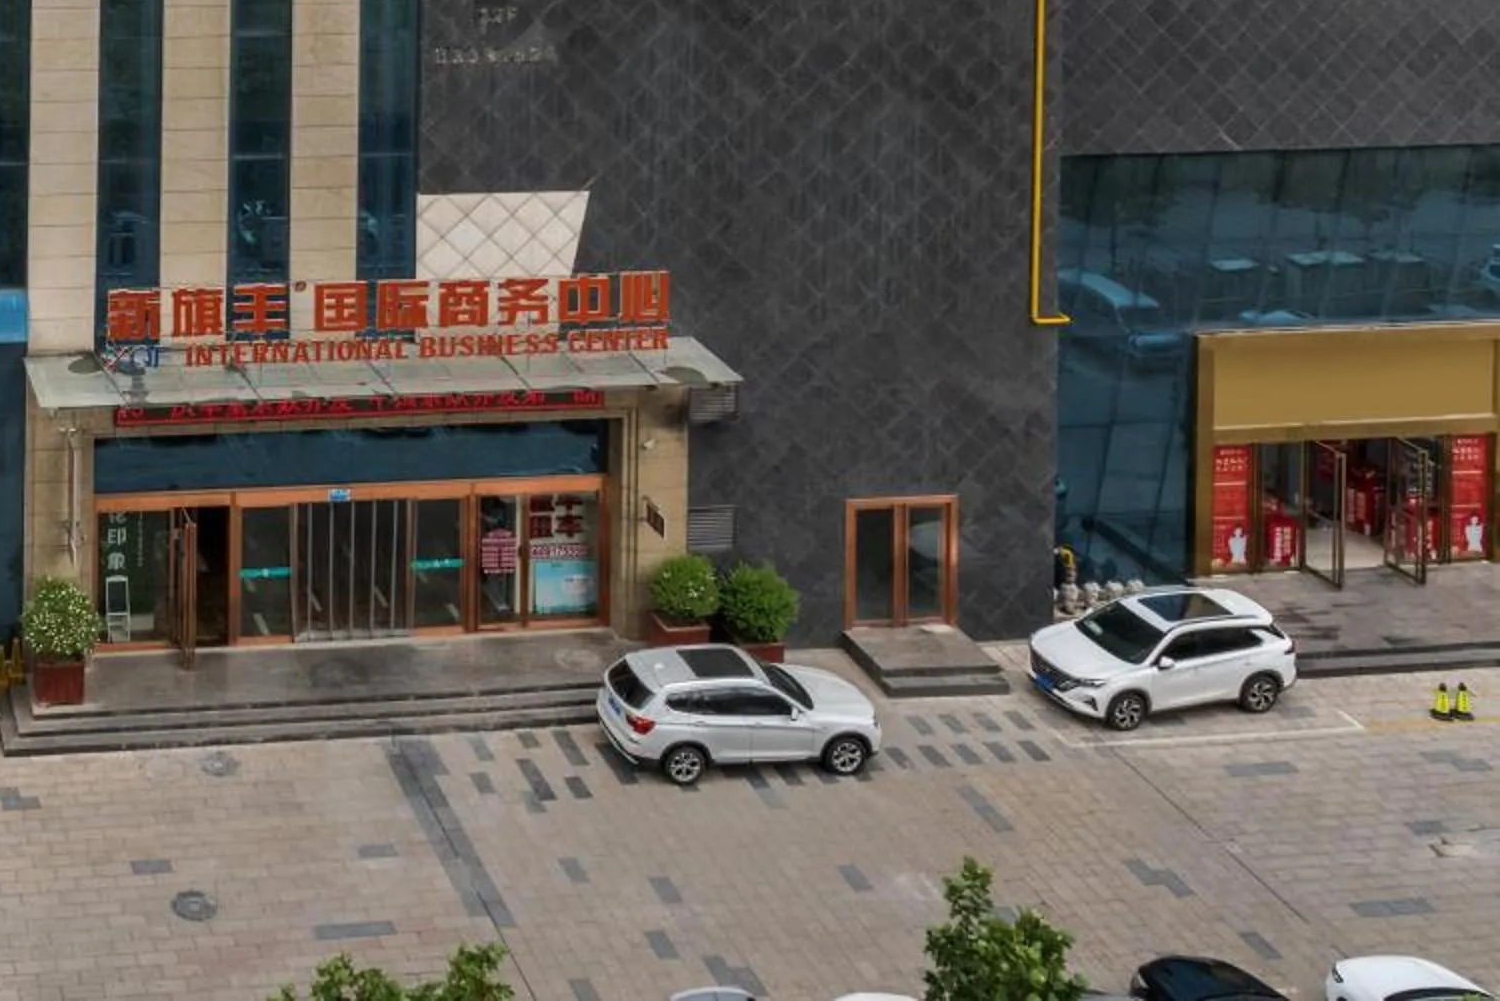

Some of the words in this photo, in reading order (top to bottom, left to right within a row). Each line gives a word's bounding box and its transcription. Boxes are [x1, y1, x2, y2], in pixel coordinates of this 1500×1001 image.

[184, 340, 409, 368] INTERNATIONAL
[418, 333, 558, 359] BUSINESS
[567, 326, 670, 352] CENTER
